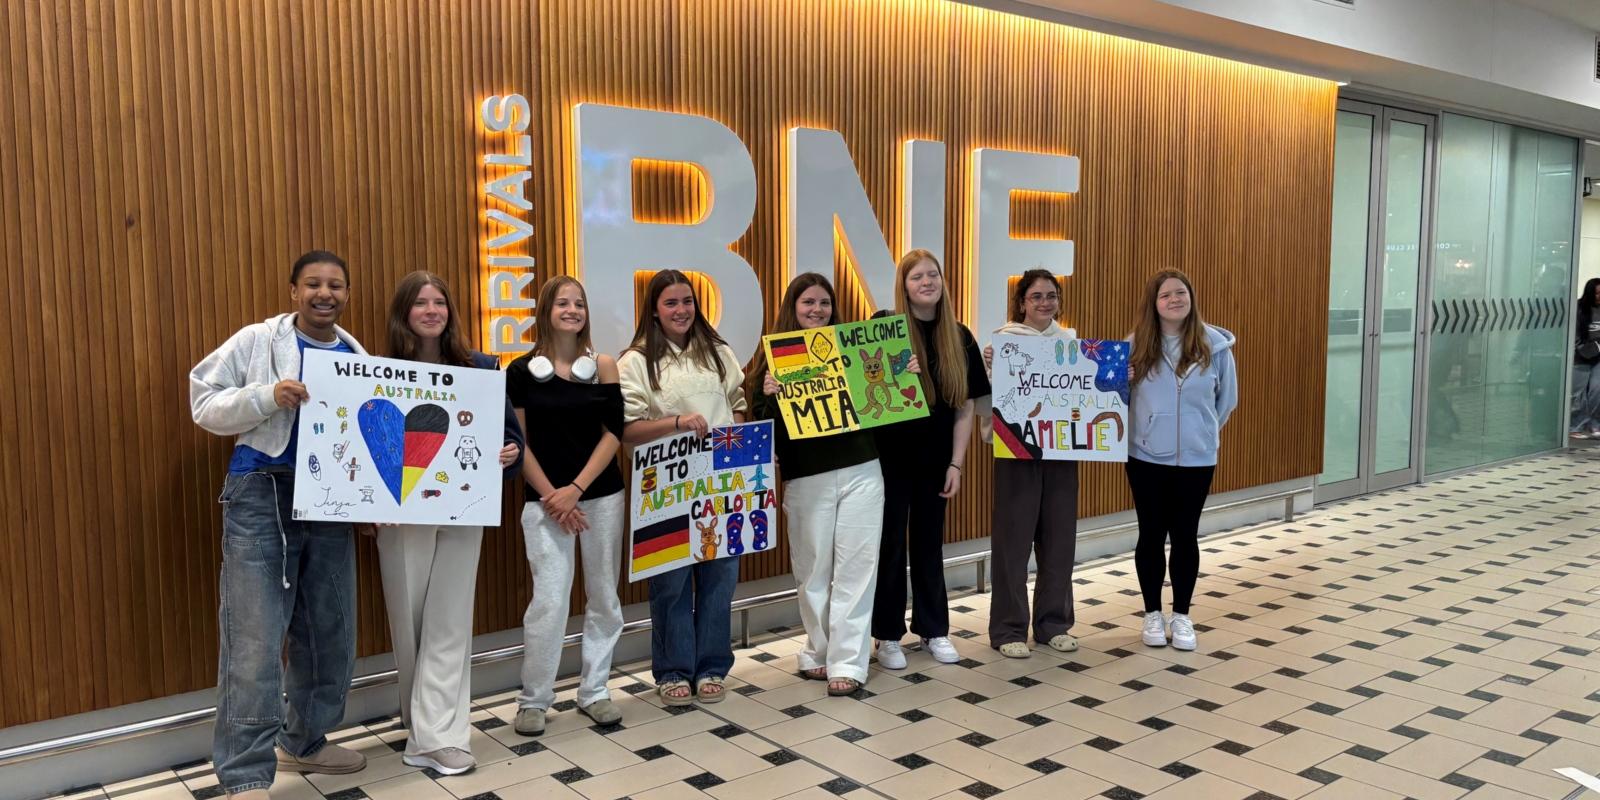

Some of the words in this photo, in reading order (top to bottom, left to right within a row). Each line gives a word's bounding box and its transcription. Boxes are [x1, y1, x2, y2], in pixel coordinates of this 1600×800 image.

[573, 102, 1080, 373] BNE
[839, 320, 906, 348] WELCOME
[334, 361, 417, 382] WELCOME
[428, 372, 454, 386] TO
[827, 355, 852, 373] TO
[373, 384, 457, 402] AUSTRALIA
[777, 375, 846, 400] AUSTRALIA
[1017, 386, 1032, 396] TO
[1019, 371, 1093, 390] WELCOME
[790, 390, 860, 435] MIA
[1041, 393, 1122, 409] AUSTRALIA
[635, 433, 713, 471] WELCOME
[665, 459, 688, 482] TO
[640, 471, 745, 516] AUSTRALIA
[691, 489, 777, 520] CARLOTTA
